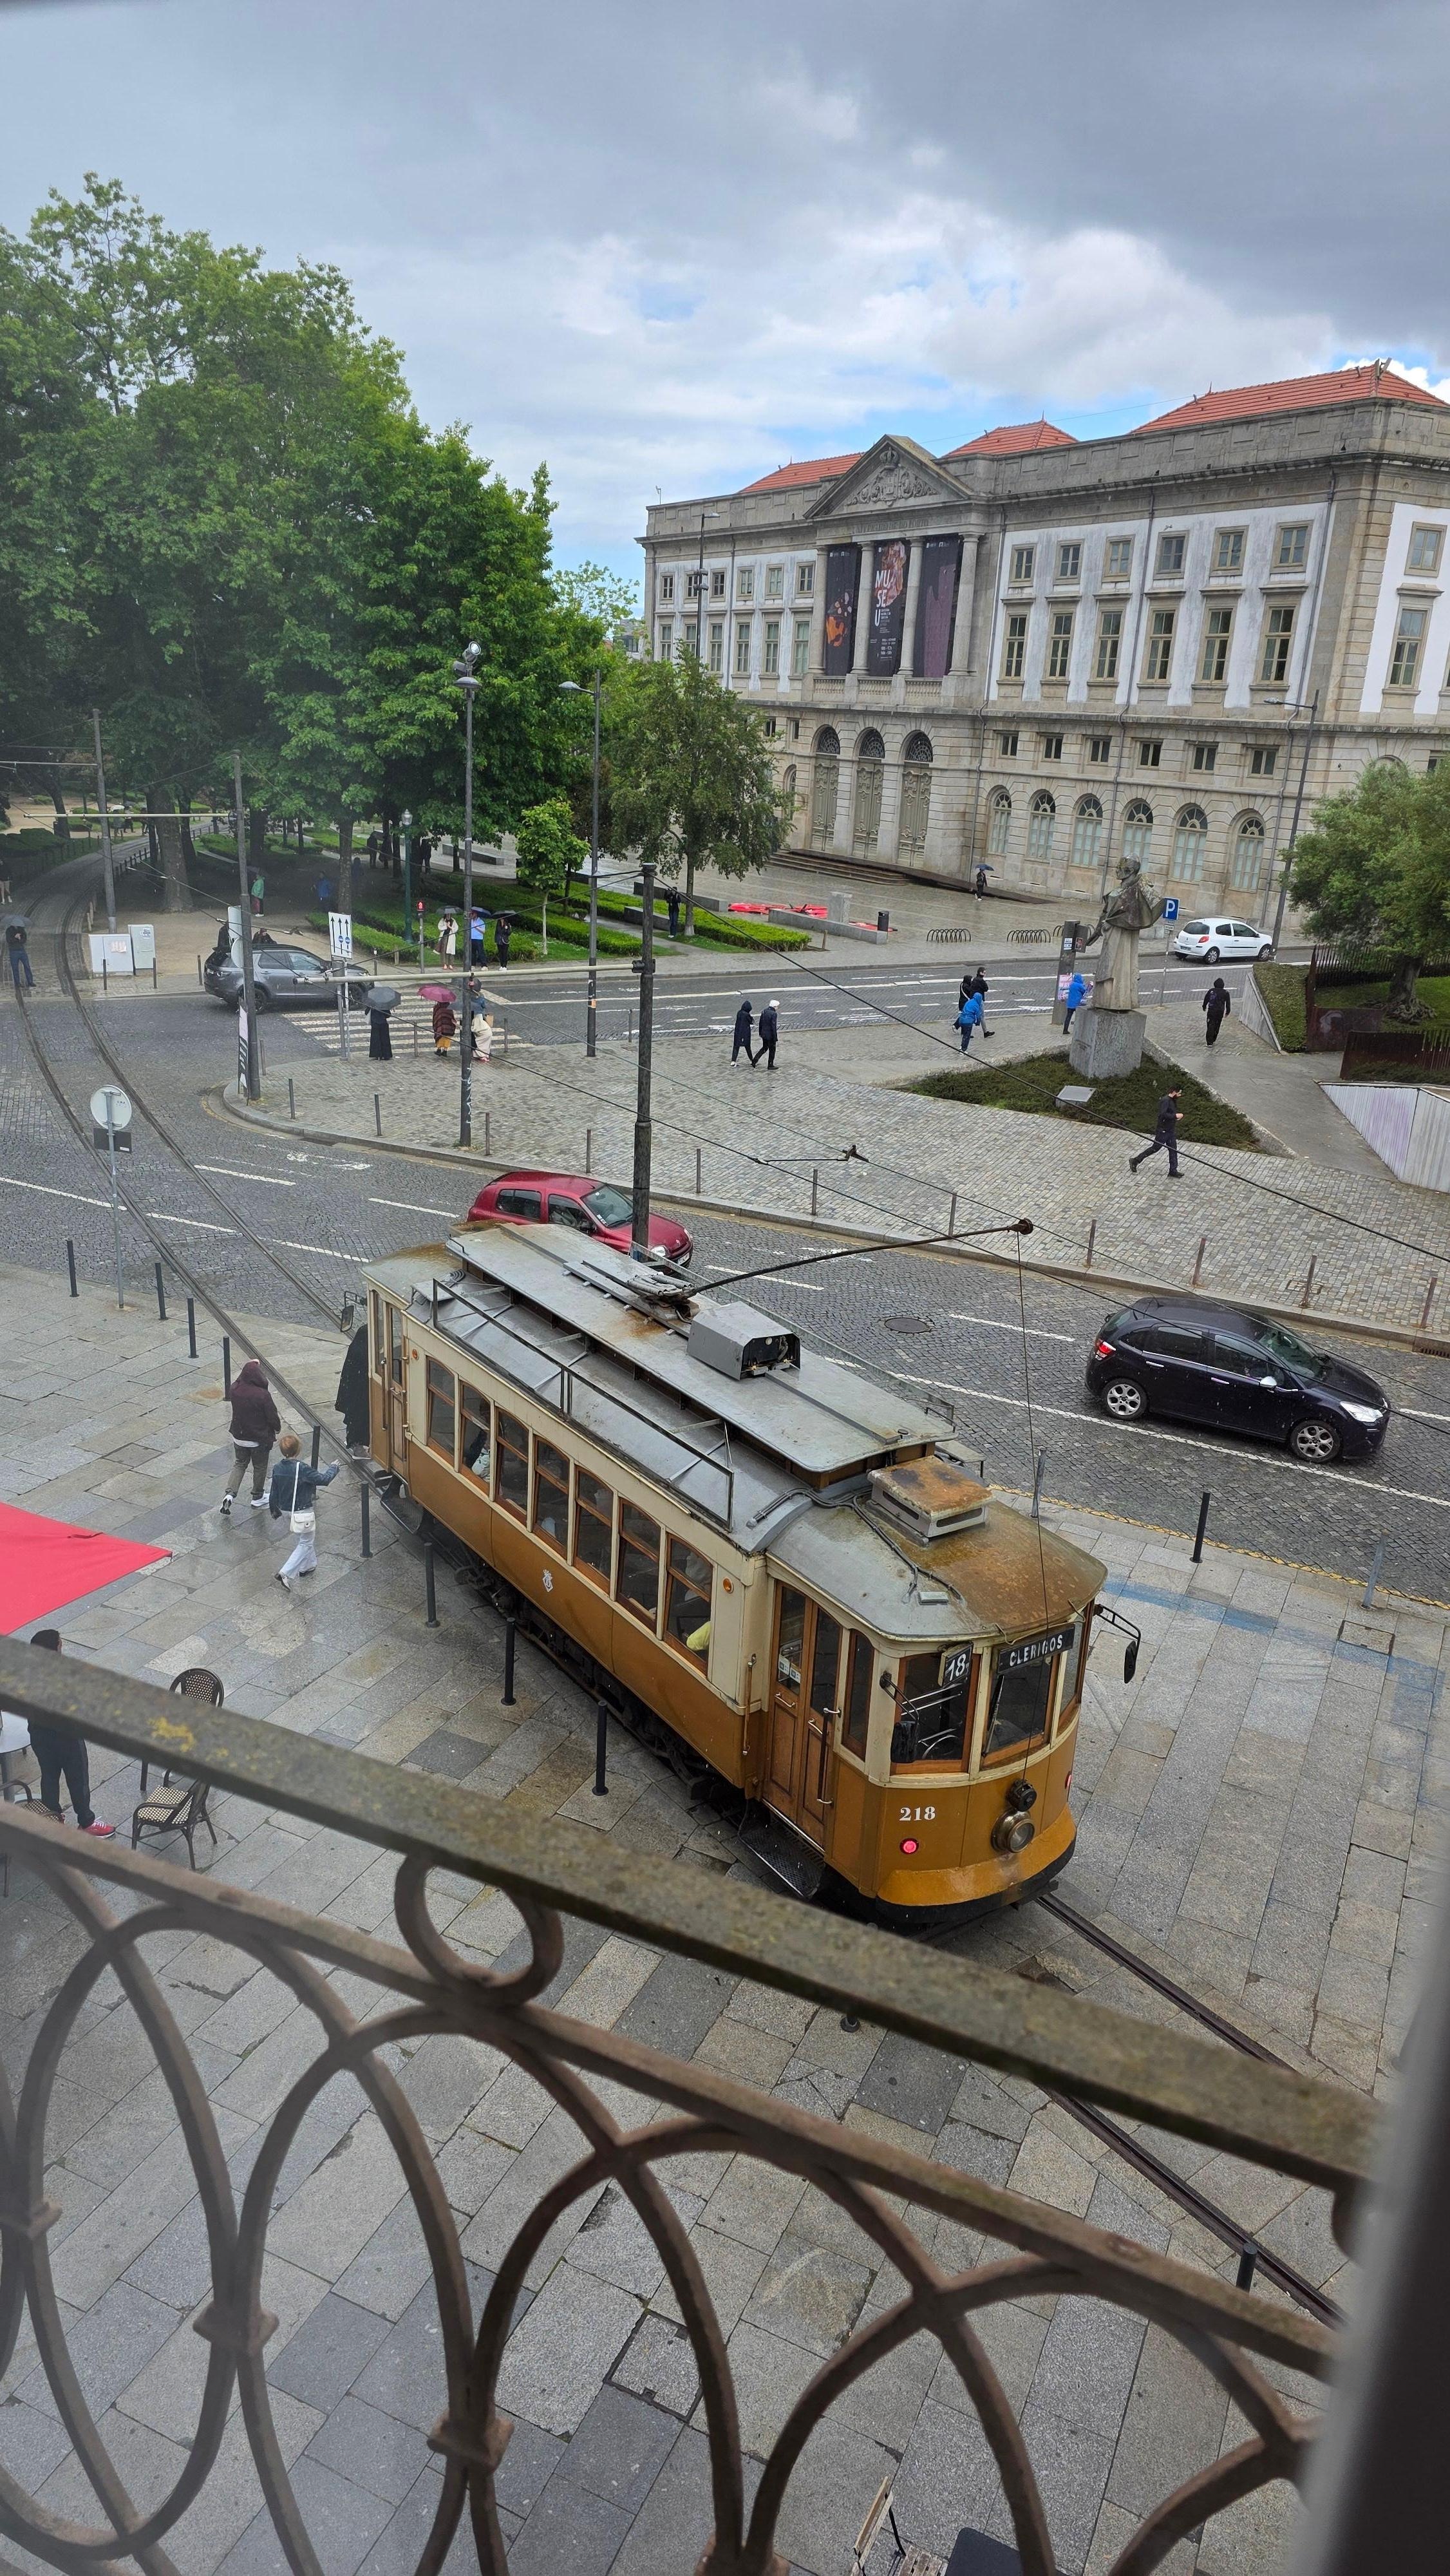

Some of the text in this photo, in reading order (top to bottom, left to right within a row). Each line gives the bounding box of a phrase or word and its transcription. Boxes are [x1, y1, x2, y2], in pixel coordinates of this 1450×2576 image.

[875, 570, 890, 588] MU
[876, 589, 887, 607] SE
[874, 609, 881, 627] U
[1165, 900, 1176, 918] P
[1010, 1634, 1063, 1667] CLERIGOS
[945, 1653, 966, 1681] 18
[899, 1806, 936, 1821] 218
